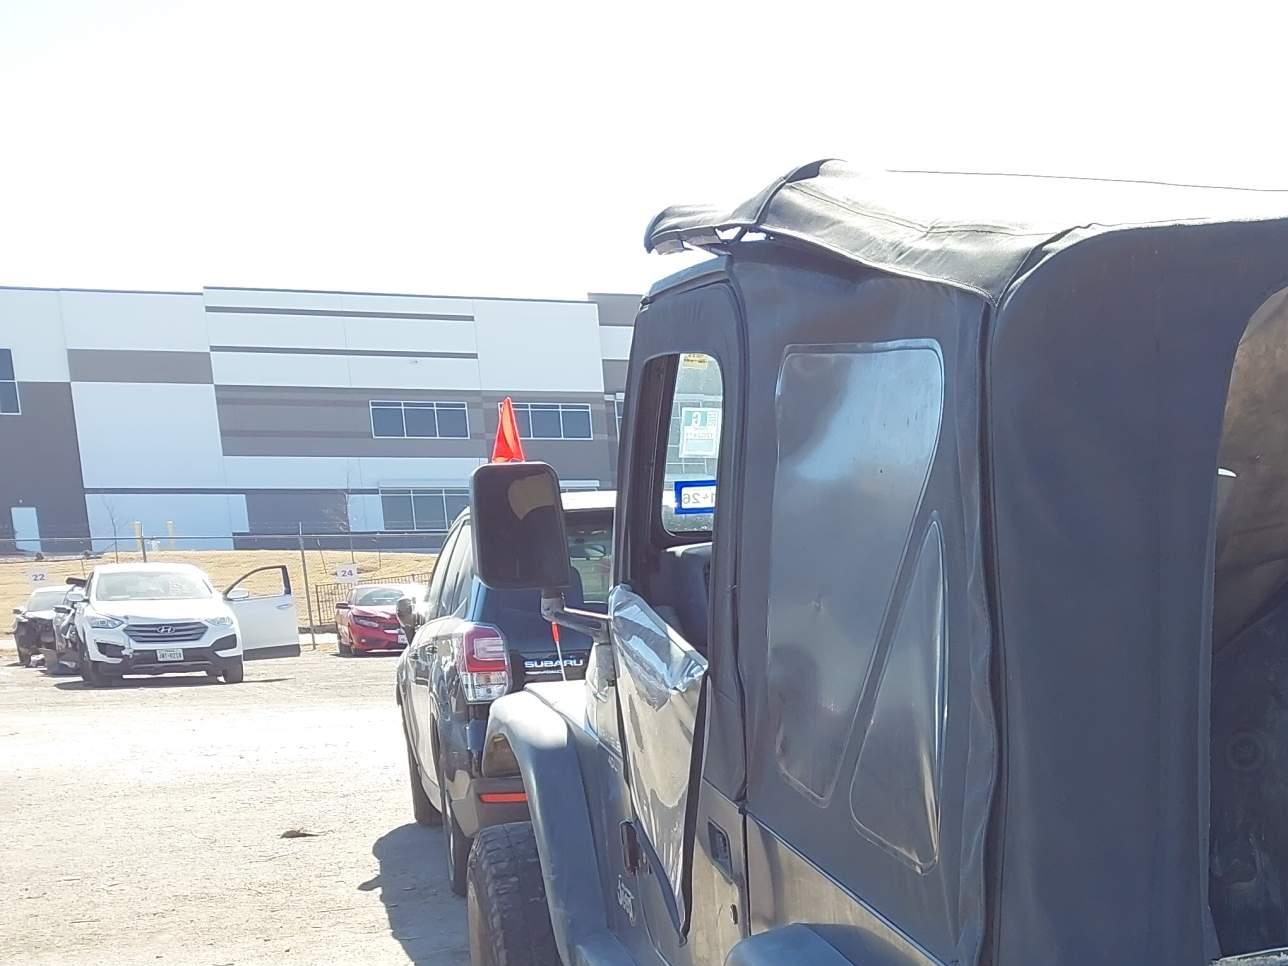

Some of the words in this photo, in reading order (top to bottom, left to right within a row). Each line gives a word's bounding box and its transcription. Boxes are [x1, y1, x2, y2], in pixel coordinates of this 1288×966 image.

[32, 573, 46, 581] 22
[341, 569, 353, 577] 24
[524, 659, 584, 668] SUBARU
